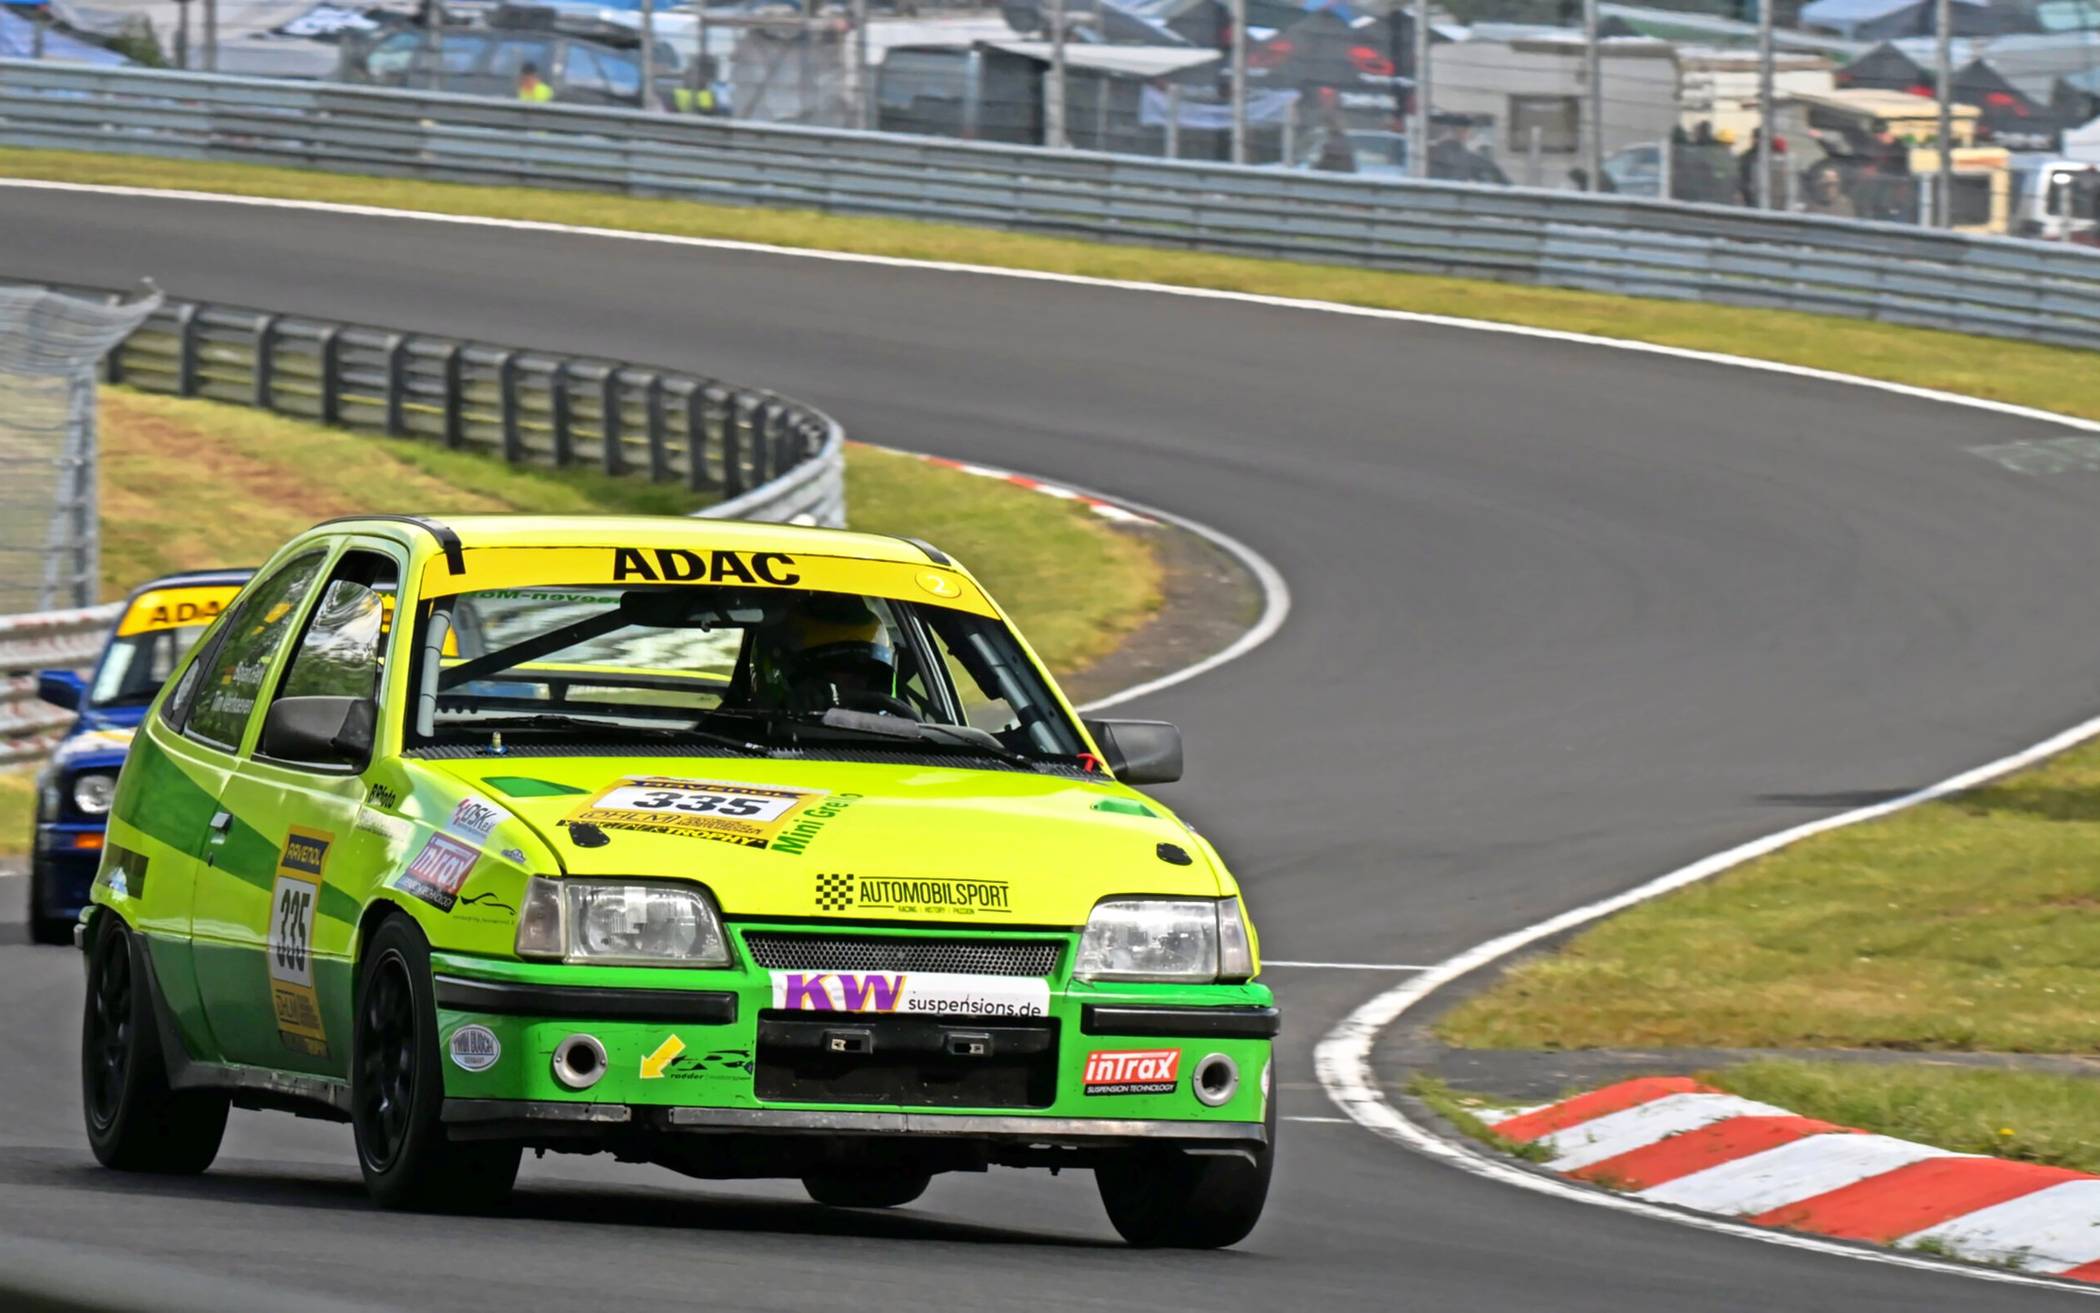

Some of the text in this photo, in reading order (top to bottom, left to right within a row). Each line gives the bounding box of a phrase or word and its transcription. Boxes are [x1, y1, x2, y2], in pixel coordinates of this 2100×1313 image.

[613, 547, 800, 586] ADAC
[926, 574, 950, 594] 2
[633, 791, 769, 816] 335
[667, 828, 760, 847] TROPHY
[770, 820, 824, 855] Mini
[860, 881, 1009, 907] AUTOMOBILSPORT
[277, 889, 311, 972] 335
[785, 974, 1041, 1017] KW suspensions.de
[1085, 1051, 1178, 1081] inTrax
[1087, 1083, 1174, 1094] SUSPENSION TECHNOLOGY
